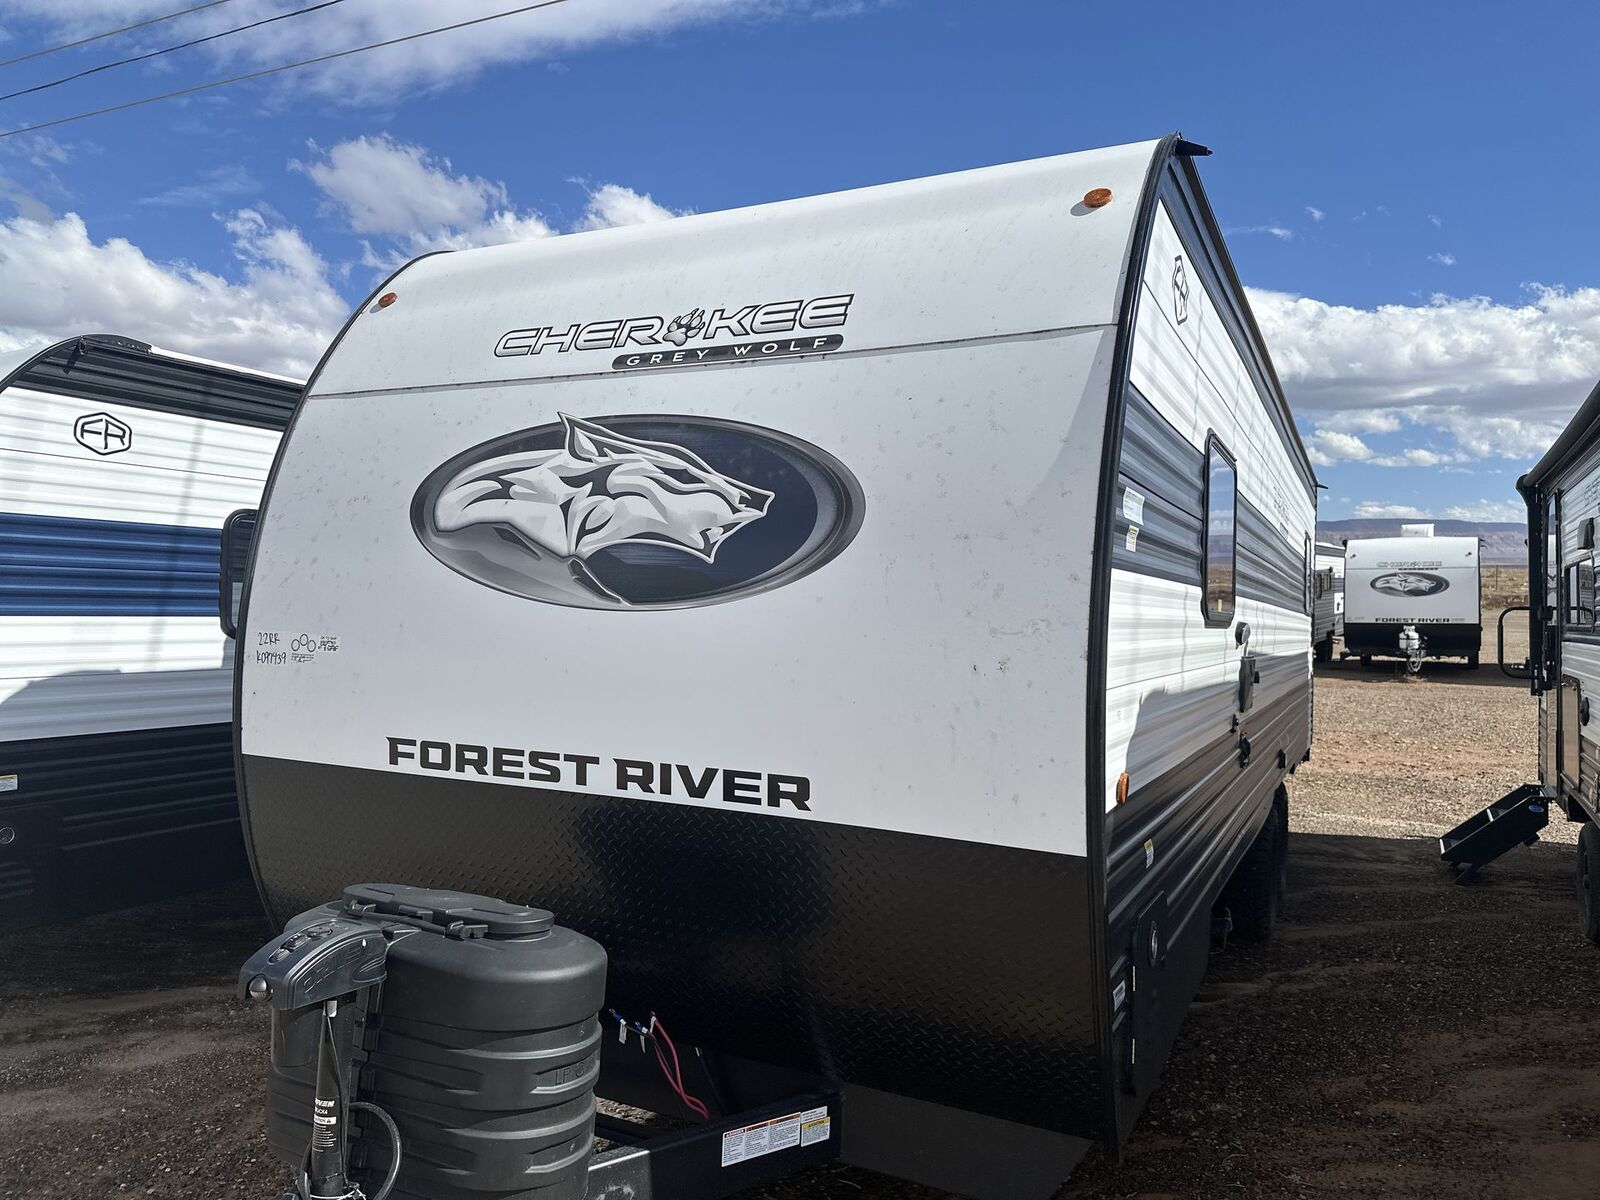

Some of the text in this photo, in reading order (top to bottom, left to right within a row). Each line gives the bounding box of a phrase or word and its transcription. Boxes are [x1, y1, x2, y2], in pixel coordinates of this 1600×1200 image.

[626, 337, 828, 366] GREY WOLF
[386, 736, 812, 811] FOREST RIVER
